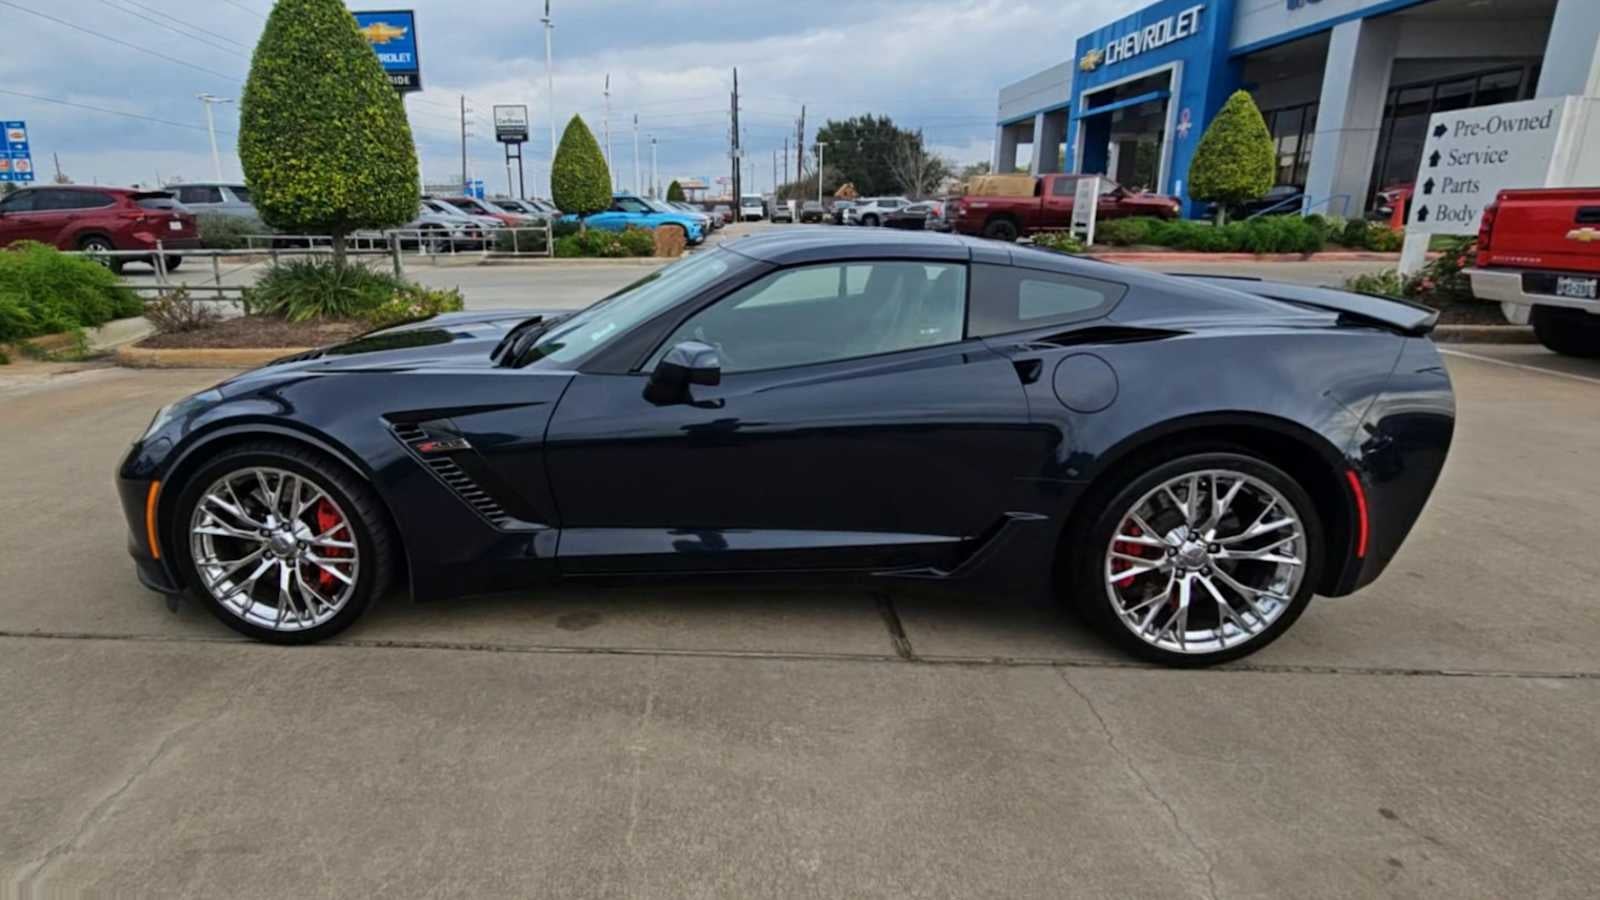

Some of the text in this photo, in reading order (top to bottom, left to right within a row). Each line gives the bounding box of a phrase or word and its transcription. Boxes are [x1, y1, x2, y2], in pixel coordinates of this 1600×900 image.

[1104, 5, 1205, 66] CHEVROLET
[1453, 109, 1553, 137] Pre-Owned
[1447, 145, 1509, 166] Service
[1441, 177, 1480, 194] Parts
[1435, 204, 1477, 226] Body
